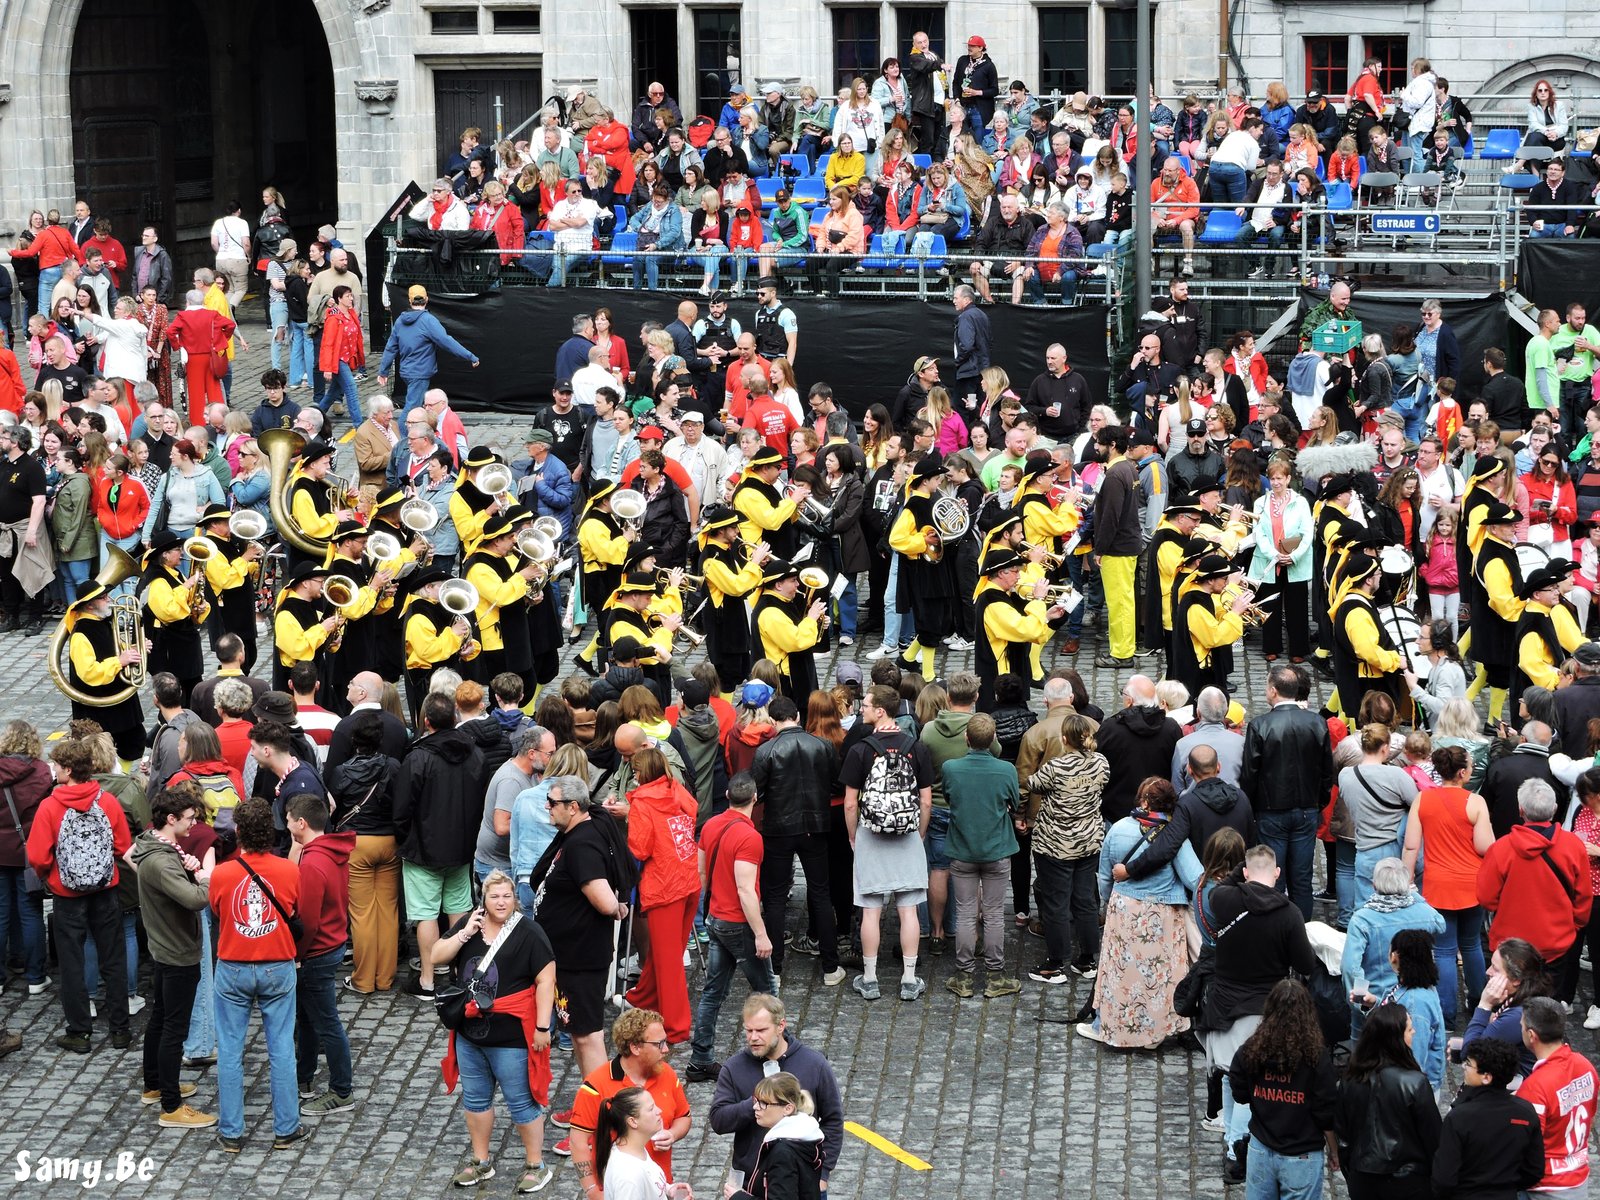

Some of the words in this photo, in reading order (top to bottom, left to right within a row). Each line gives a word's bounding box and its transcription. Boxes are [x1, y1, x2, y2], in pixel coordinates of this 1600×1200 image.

[1376, 219, 1416, 229] ESTRADE
[1424, 216, 1435, 230] C
[1253, 1085, 1305, 1105] MANAGER
[1565, 1104, 1589, 1155] 16
